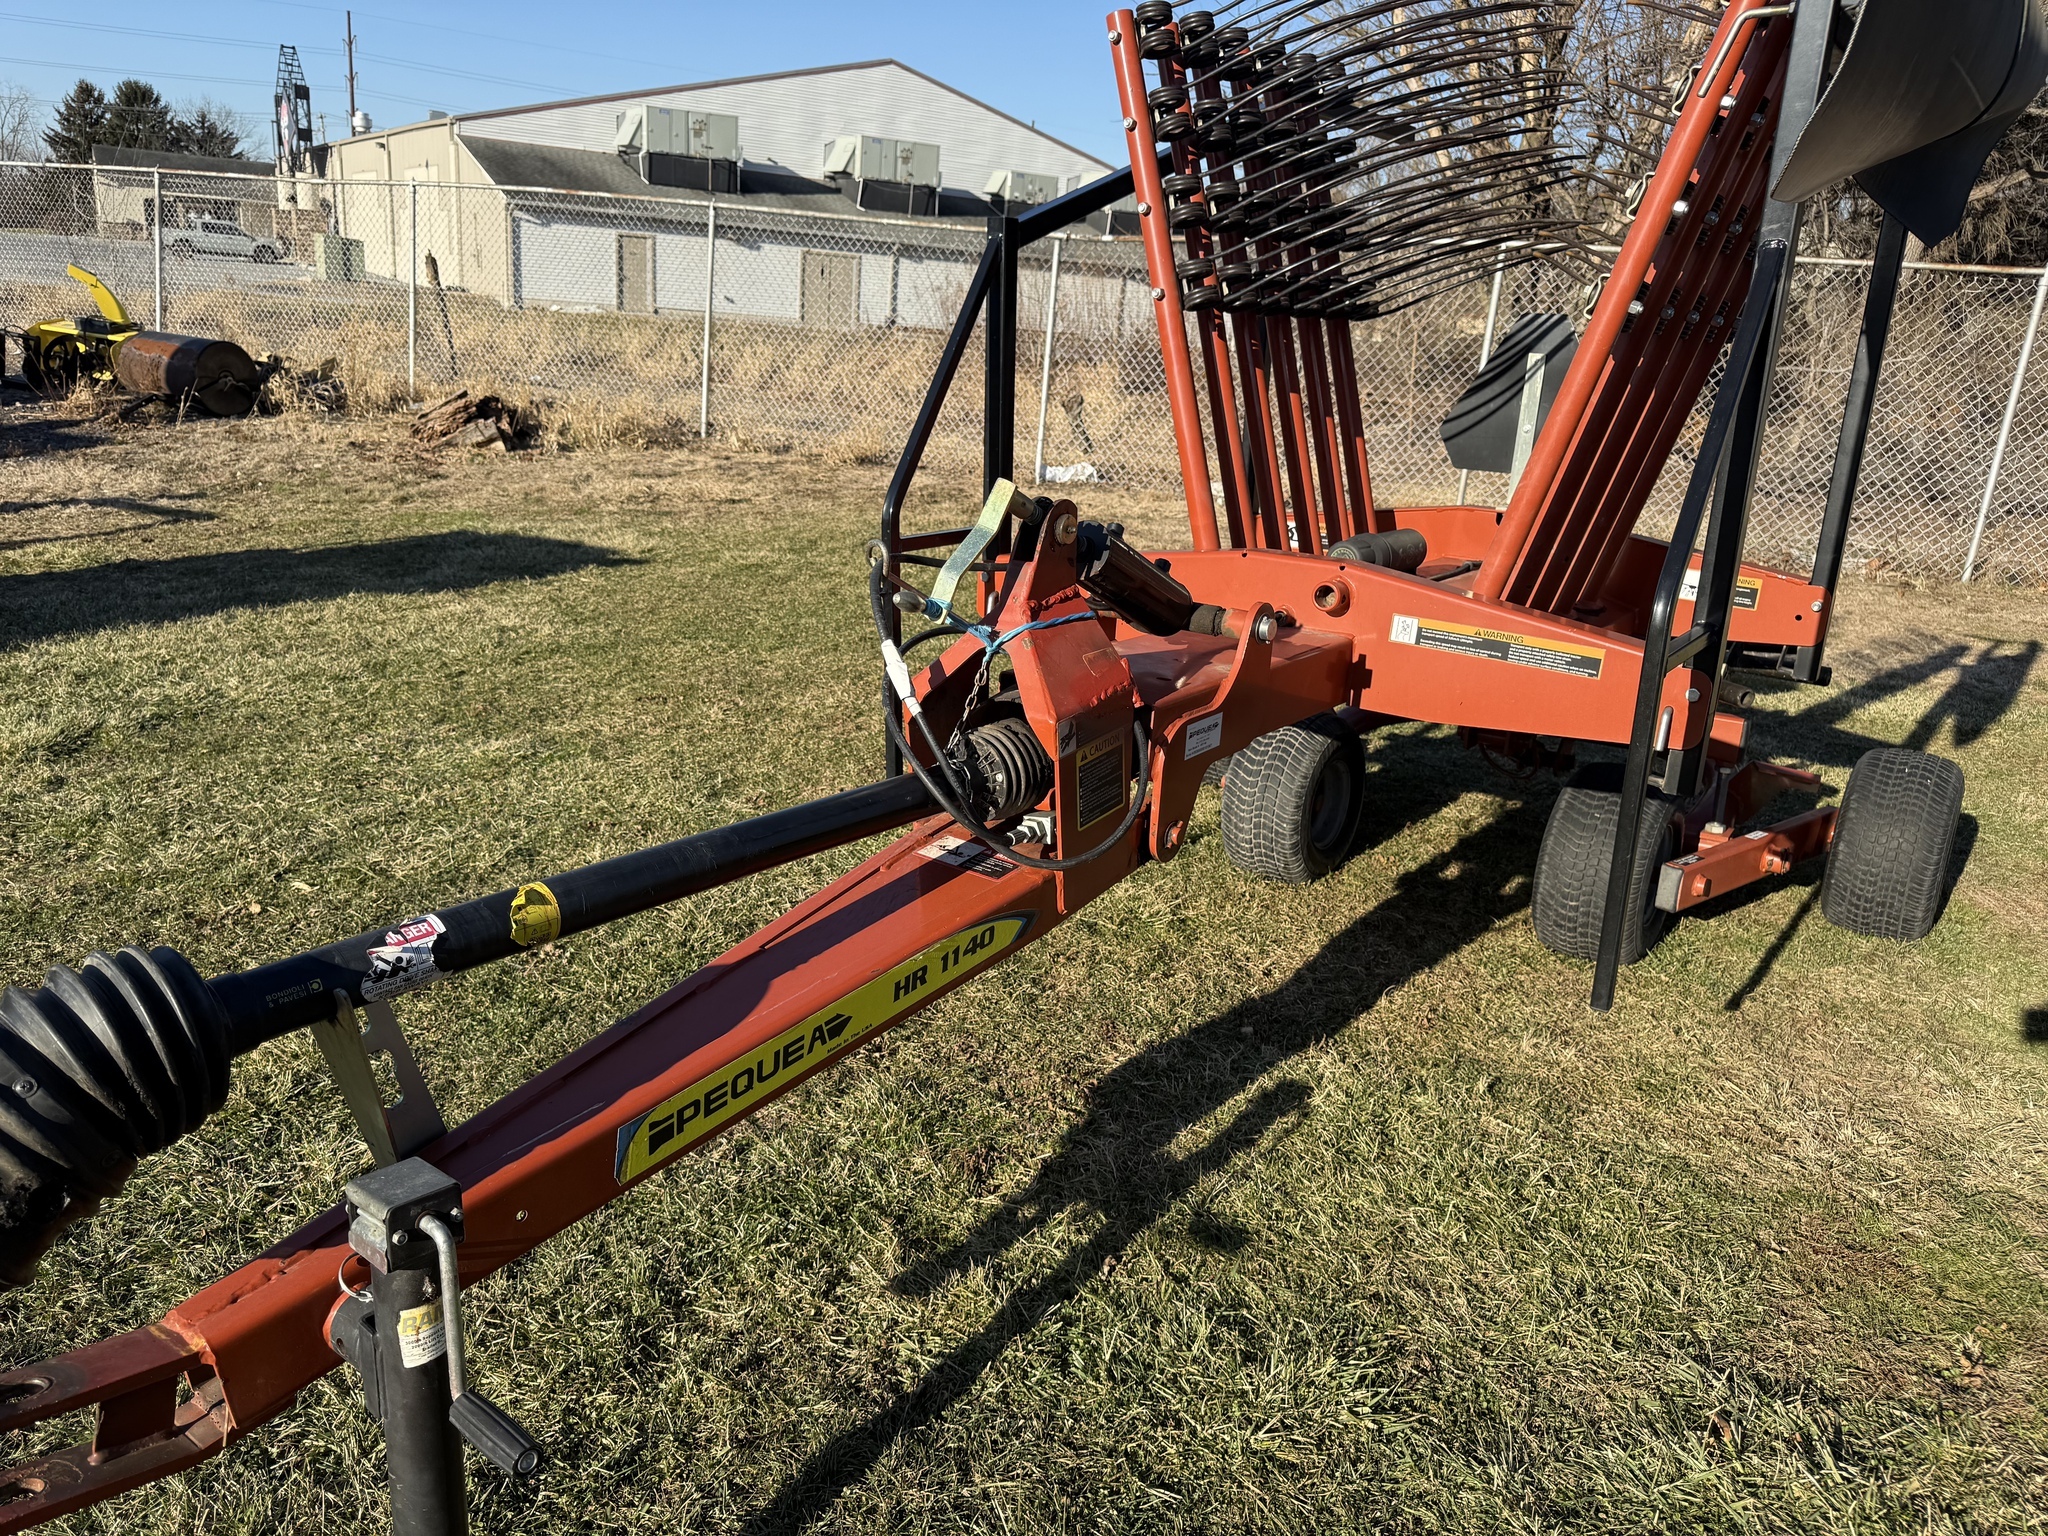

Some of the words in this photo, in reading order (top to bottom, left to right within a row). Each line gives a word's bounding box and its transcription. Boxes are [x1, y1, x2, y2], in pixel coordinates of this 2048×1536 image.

[1738, 578, 1756, 586] NING
[1483, 629, 1524, 643] WARNING
[1089, 733, 1120, 757] CAUTION
[384, 922, 433, 944] ANGER
[893, 964, 928, 1003] HR
[941, 925, 995, 973] 1140
[265, 984, 305, 1002] BONDIOLI
[278, 990, 307, 1004] PAVESI
[363, 981, 398, 996] ROTATING
[676, 1023, 828, 1136] PEQUEA
